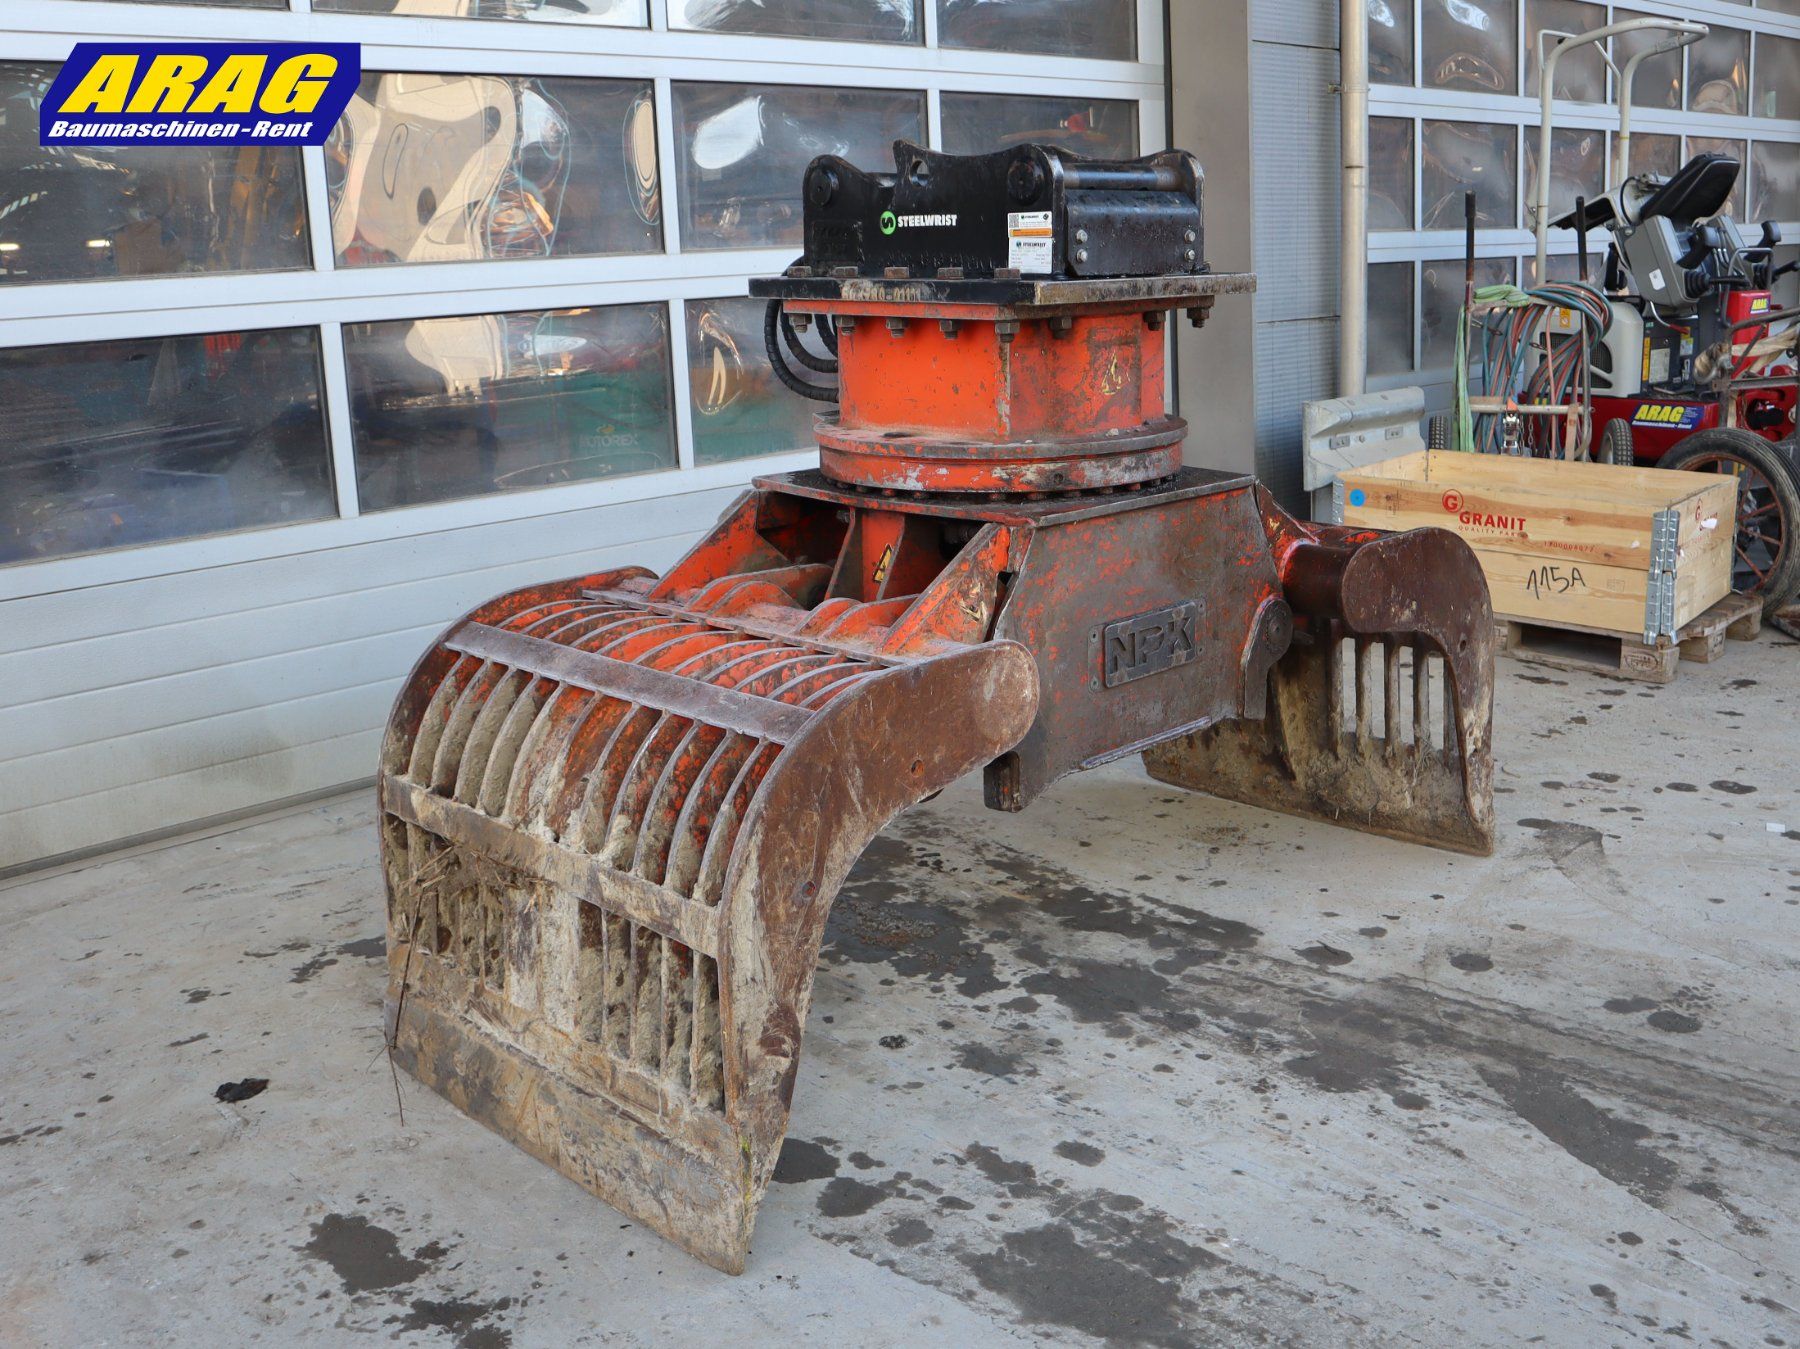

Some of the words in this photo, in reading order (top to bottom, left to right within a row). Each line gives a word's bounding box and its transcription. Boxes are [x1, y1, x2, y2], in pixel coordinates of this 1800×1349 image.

[897, 214, 958, 228] STEELWRIST
[1634, 404, 1685, 423] ARAG
[1458, 525, 1494, 534] QUALITY
[1459, 511, 1526, 531] GRANIT
[1109, 616, 1193, 675] NPK
